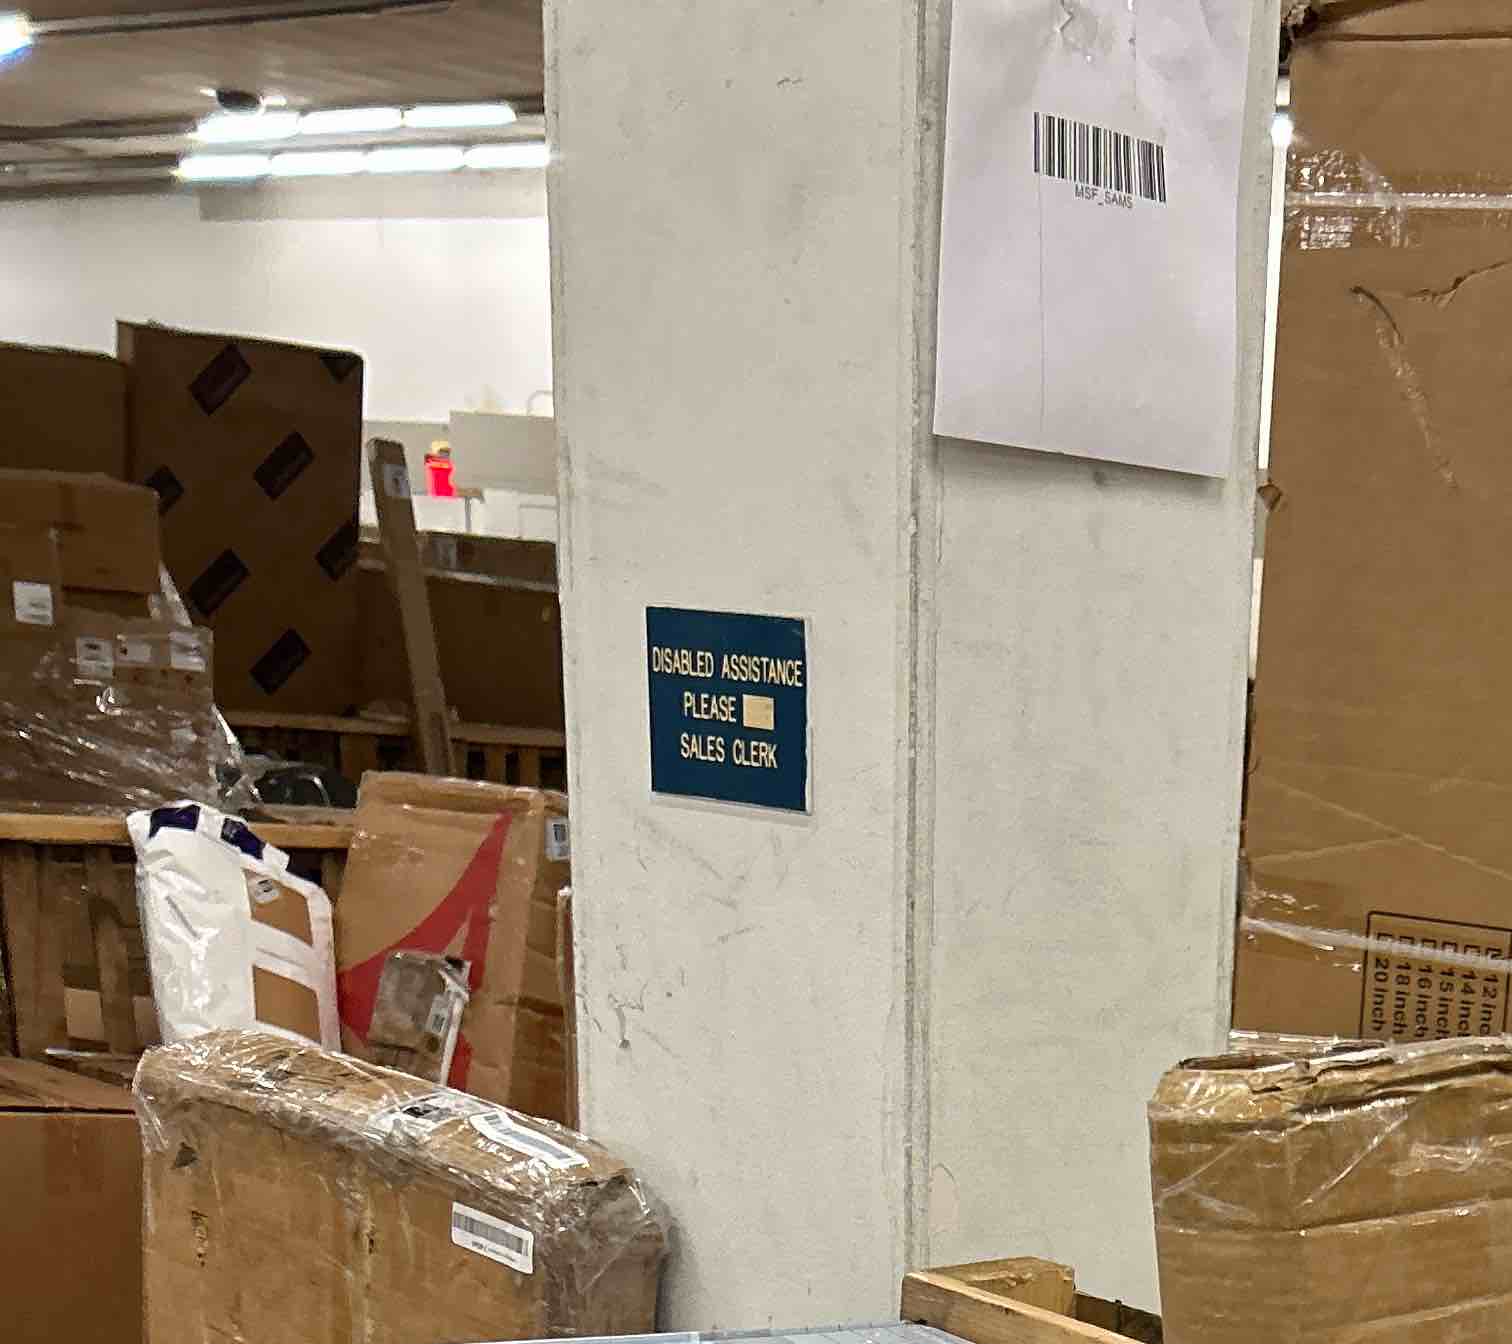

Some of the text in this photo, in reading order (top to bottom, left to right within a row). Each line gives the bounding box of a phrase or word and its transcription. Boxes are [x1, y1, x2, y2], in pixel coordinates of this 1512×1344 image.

[1074, 184, 1133, 209] MSF_SAMS
[652, 646, 803, 687] DISABLED ASSISTANCE
[683, 691, 737, 723] PLEASE
[680, 732, 778, 768] SALES CLERK
[1374, 957, 1390, 982] 20
[1395, 962, 1411, 986] 18
[1417, 964, 1433, 989] 16
[1439, 965, 1455, 993] 15
[1460, 970, 1476, 995] 14
[1479, 973, 1499, 1036] 12 inc
